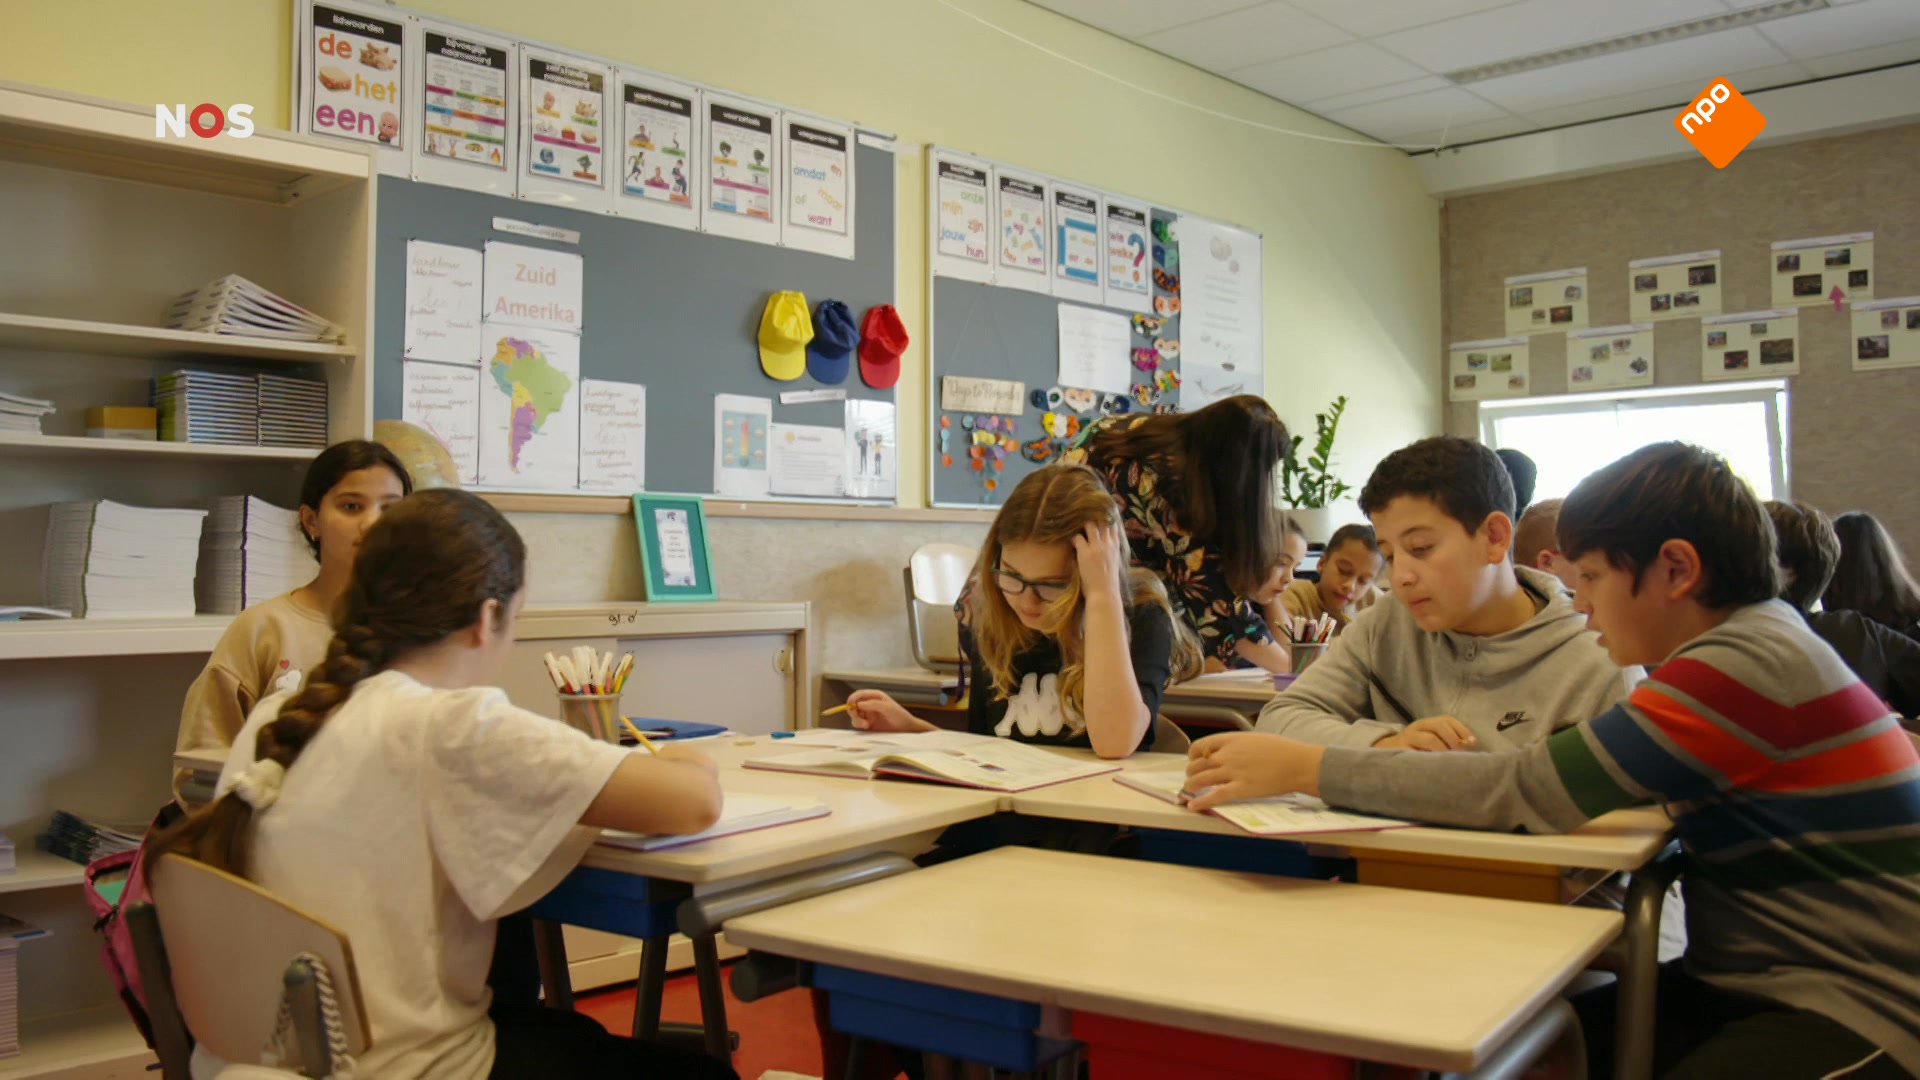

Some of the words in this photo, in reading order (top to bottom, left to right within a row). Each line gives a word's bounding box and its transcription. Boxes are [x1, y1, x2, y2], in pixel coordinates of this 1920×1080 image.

[319, 33, 352, 58] de
[355, 72, 397, 104] het
[316, 104, 375, 135] een
[793, 166, 826, 181] omdat
[831, 163, 842, 176] en
[808, 214, 832, 225] want
[942, 227, 966, 241] jouw
[967, 244, 984, 258] hun
[515, 263, 556, 286] Zuid
[495, 295, 575, 323] Amerika
